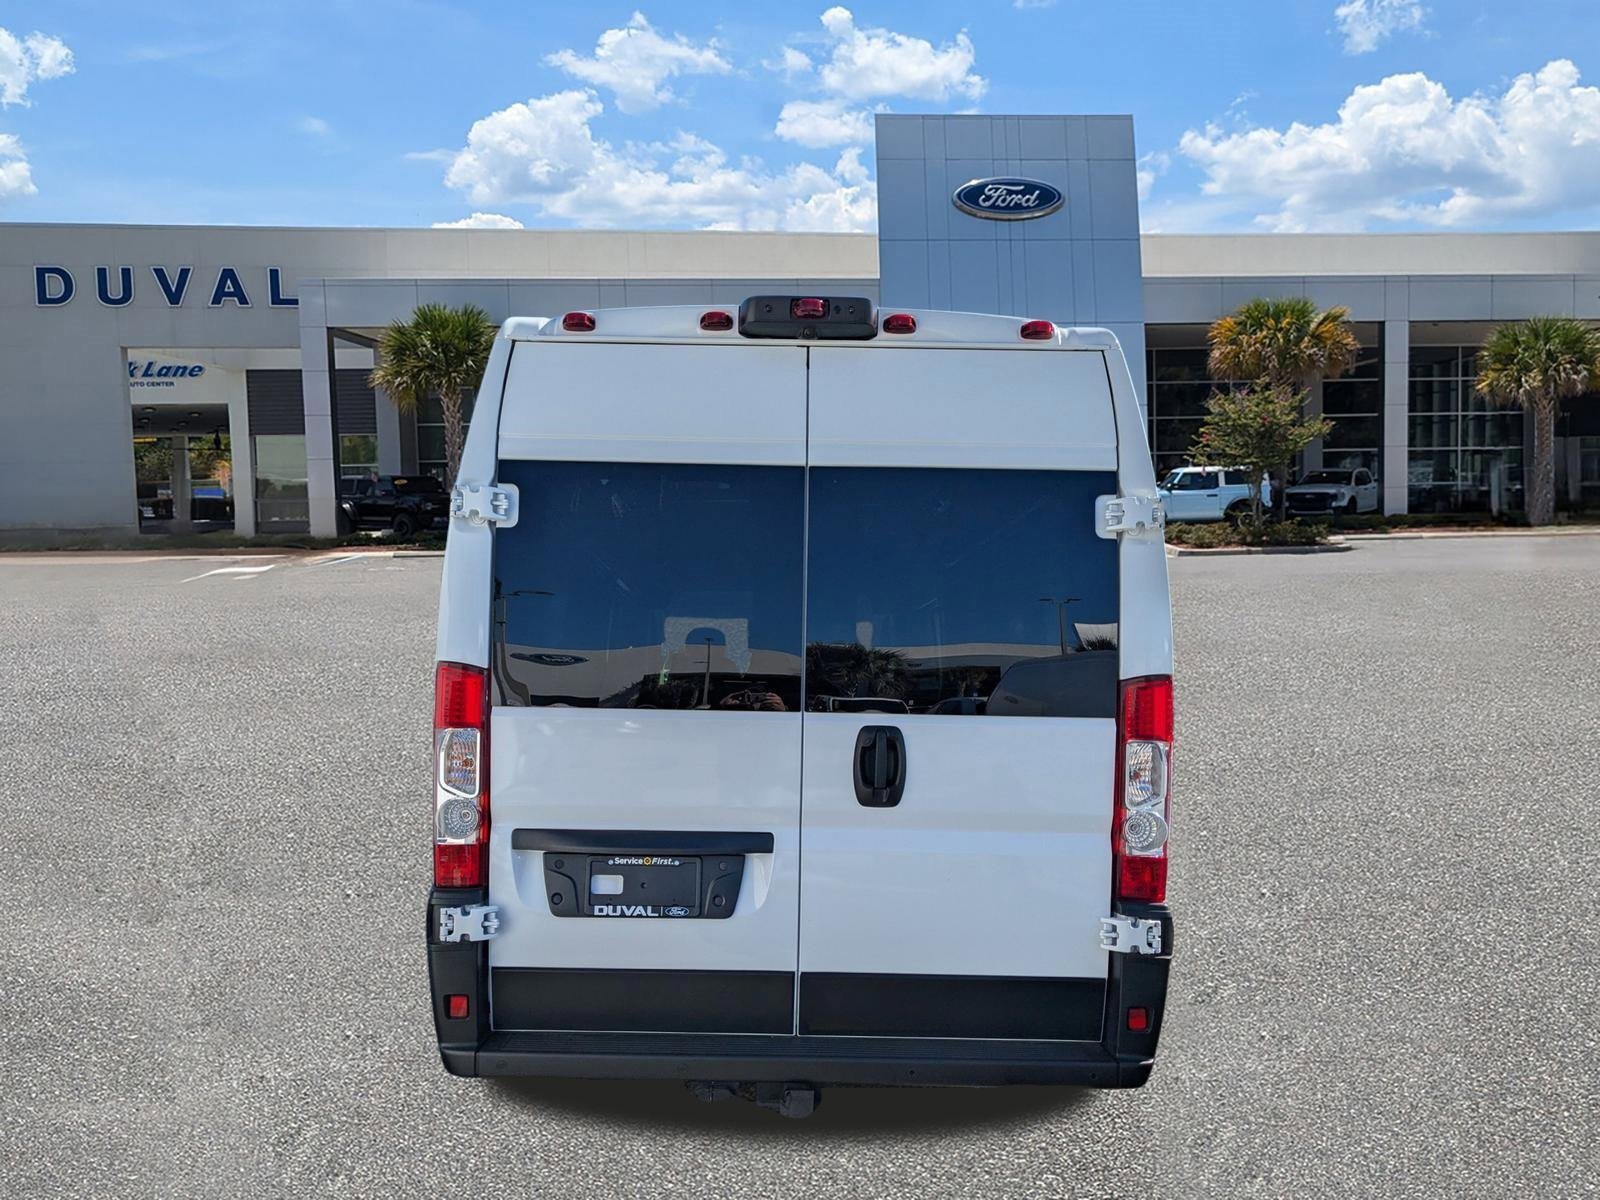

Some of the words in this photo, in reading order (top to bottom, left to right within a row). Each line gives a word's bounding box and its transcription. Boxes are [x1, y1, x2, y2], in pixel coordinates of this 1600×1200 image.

[978, 184, 1040, 207] Ford
[34, 265, 299, 308] DUVAL
[141, 361, 205, 378] Lane
[614, 857, 643, 865] Service
[593, 905, 659, 917] DUVAL
